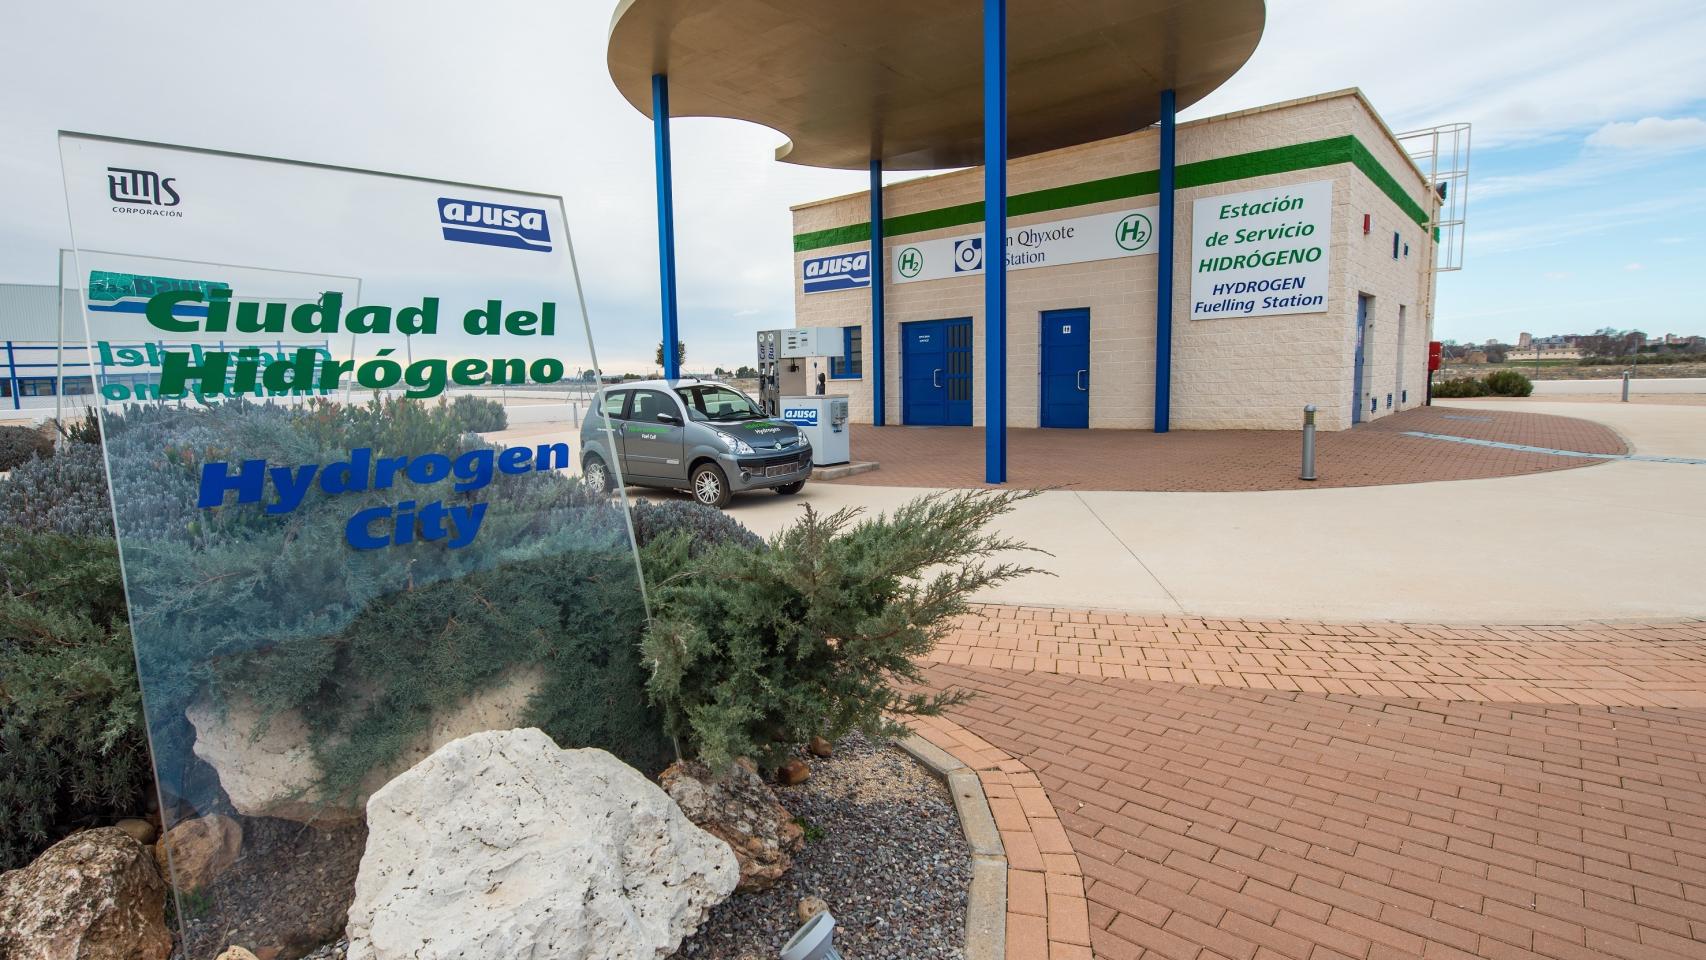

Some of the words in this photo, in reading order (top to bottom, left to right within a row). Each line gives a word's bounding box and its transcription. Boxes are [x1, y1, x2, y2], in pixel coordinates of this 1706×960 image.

[112, 206, 183, 218] CORPORACIÓN
[1219, 195, 1304, 220] Estación
[1018, 226, 1075, 249] Qhyxote
[1205, 231, 1229, 248] de
[1234, 221, 1315, 244] Servicio
[1198, 246, 1322, 273] HIDRÓGENO
[1212, 276, 1306, 296] HYDROGEN
[145, 288, 440, 335] Ciudad
[463, 299, 556, 336] del
[1194, 298, 1256, 313] Fuelling
[1262, 293, 1323, 309] Station
[160, 348, 564, 399] Hidrógeno
[197, 442, 569, 514] Hydrogen
[346, 501, 488, 550] City
